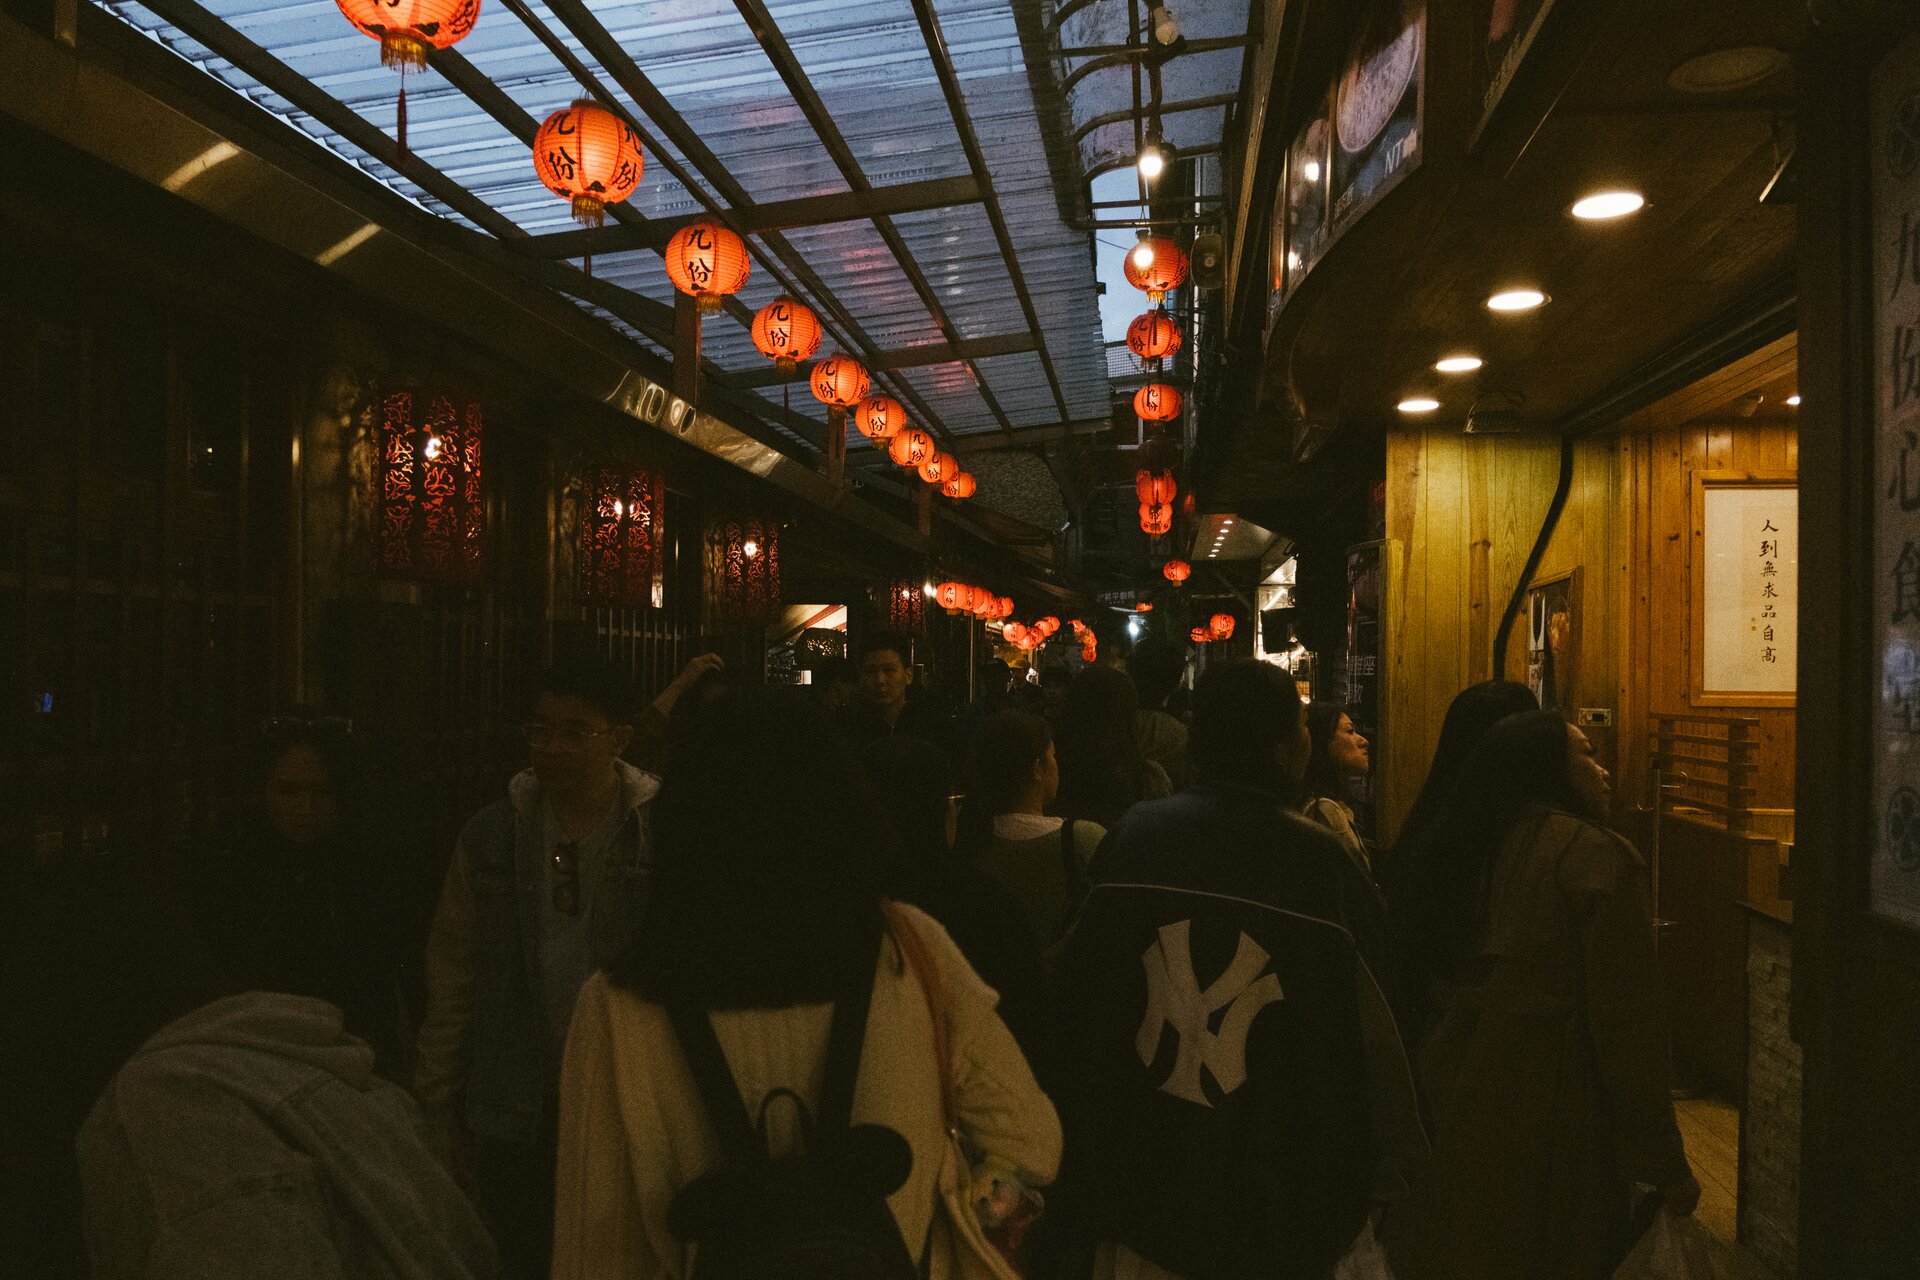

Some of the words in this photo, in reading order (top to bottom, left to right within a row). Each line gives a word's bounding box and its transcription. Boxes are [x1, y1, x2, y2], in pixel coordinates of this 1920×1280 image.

[547, 111, 577, 181] 九份
[688, 229, 713, 284] 九份
[769, 304, 789, 348] 九份
[1133, 318, 1148, 352] 九份
[820, 361, 836, 399] 九份
[871, 400, 886, 432] 九份
[912, 433, 926, 462] 九份
[1759, 519, 1779, 664] 人到無求品自高
